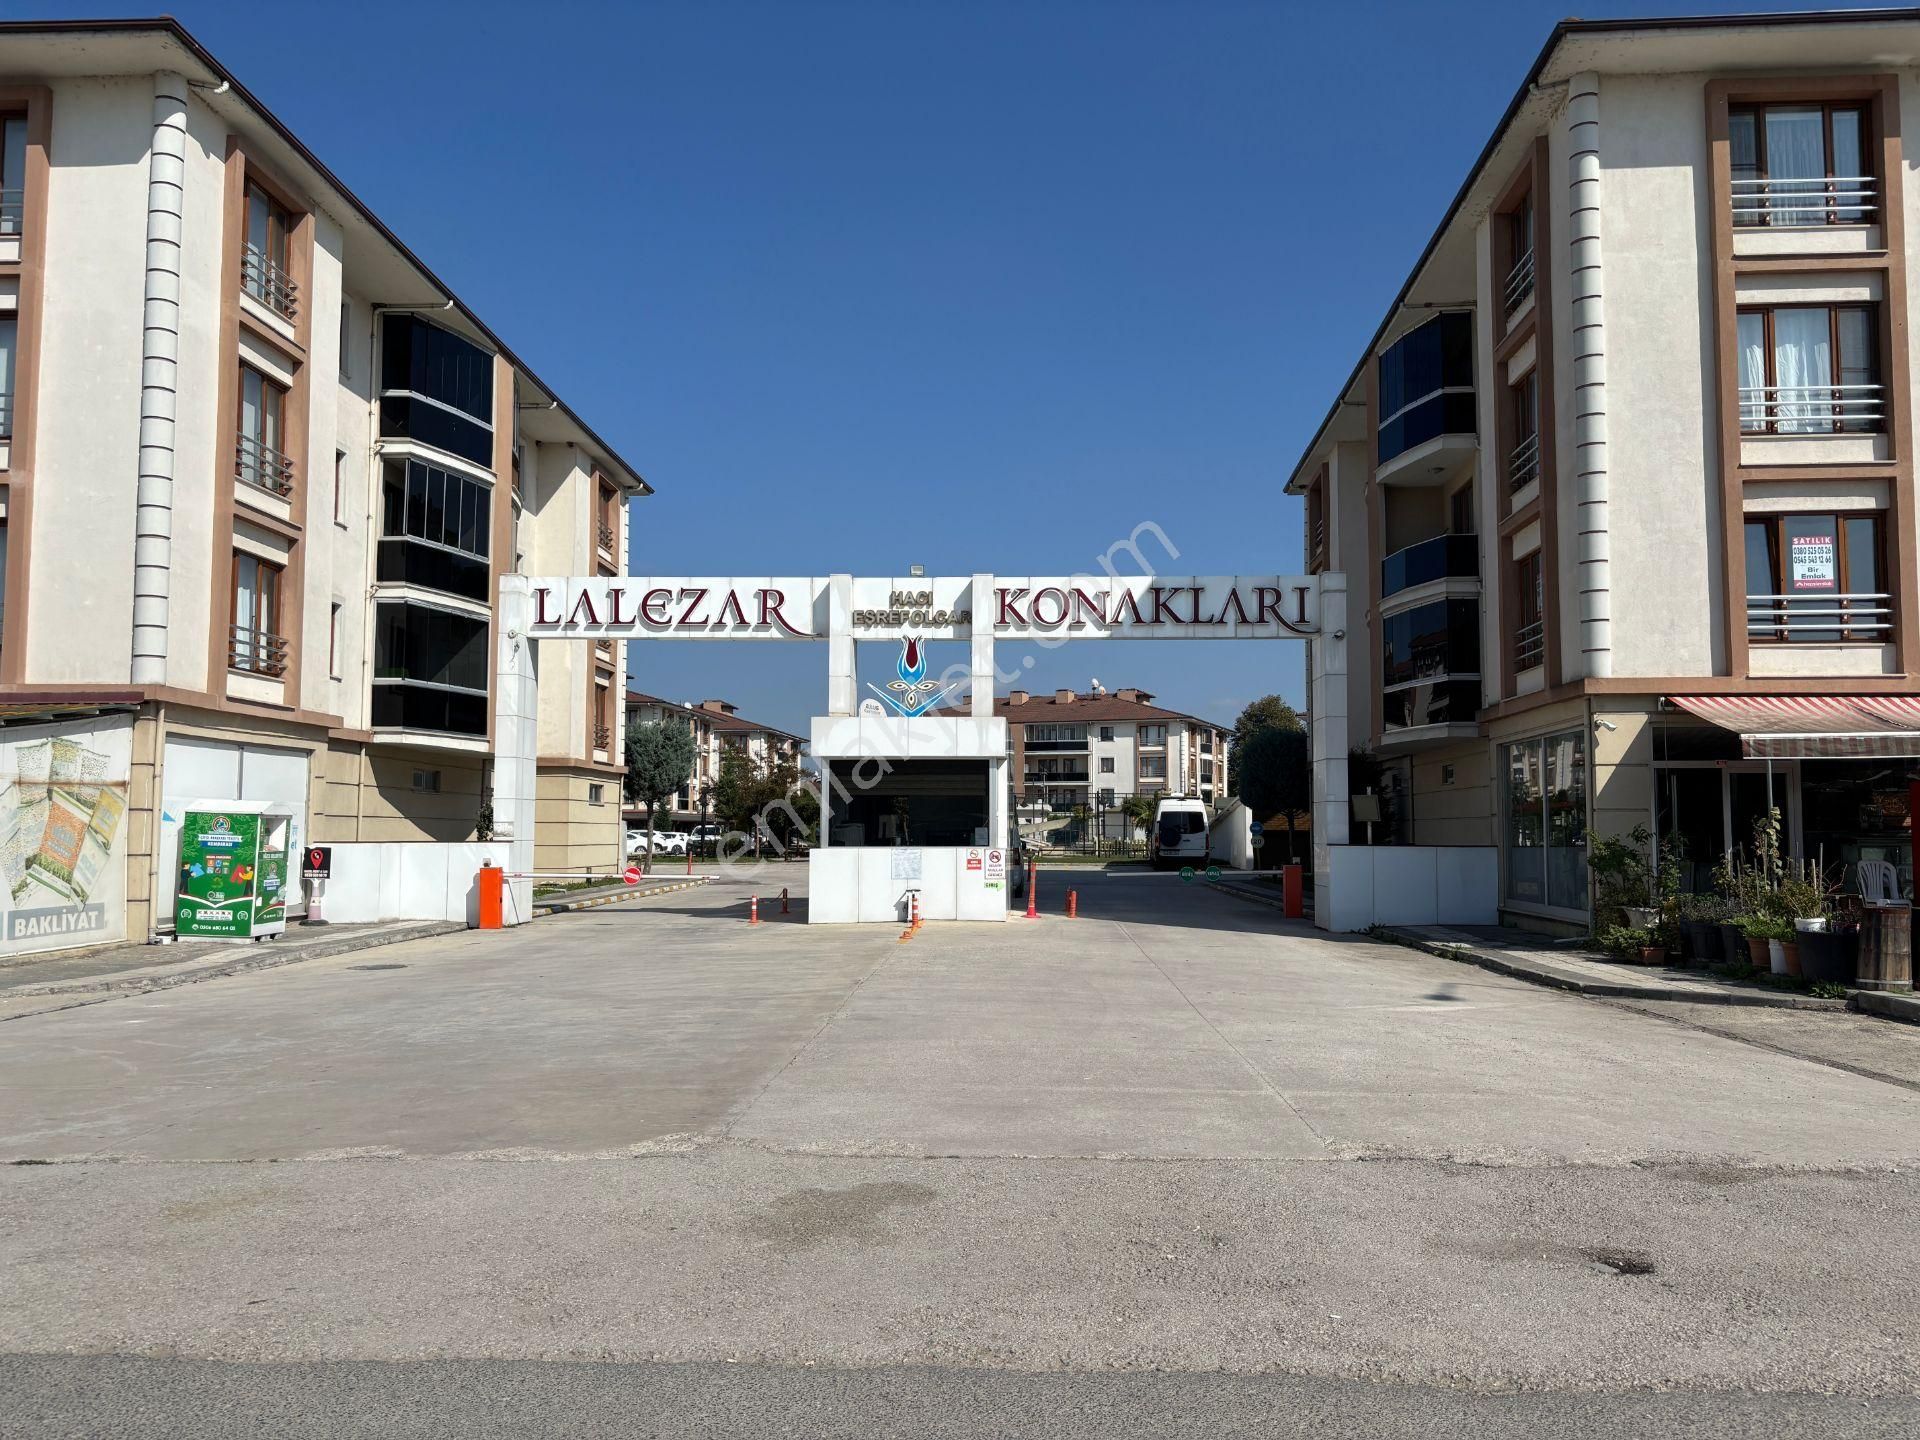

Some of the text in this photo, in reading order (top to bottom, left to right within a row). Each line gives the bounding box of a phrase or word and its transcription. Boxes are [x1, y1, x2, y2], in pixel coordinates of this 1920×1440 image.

[1794, 546, 1806, 554] 0380
[1807, 546, 1817, 555] 525
[1794, 556, 1806, 564] 0545
[890, 590, 934, 606] HACI
[532, 587, 823, 637] LALEZAR
[993, 586, 1321, 635] KONAKLARI
[14, 908, 99, 938] BAKLİYAT
